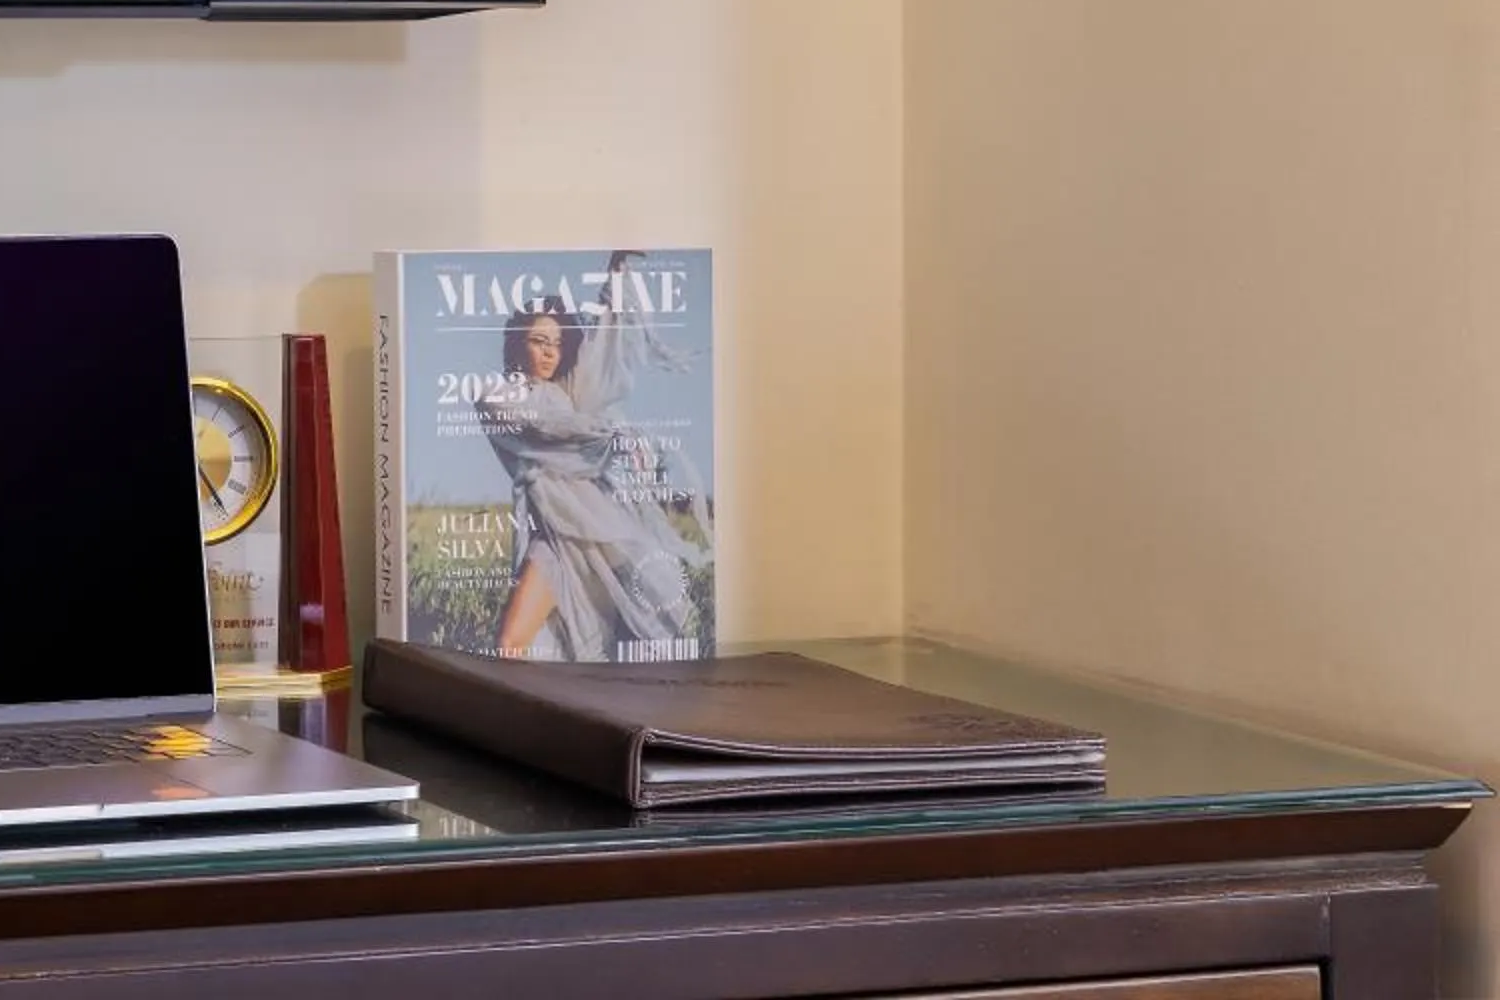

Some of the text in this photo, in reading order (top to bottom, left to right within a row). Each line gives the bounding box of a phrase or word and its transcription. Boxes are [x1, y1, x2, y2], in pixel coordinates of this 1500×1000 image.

[436, 271, 688, 317] MAGAZINE
[437, 371, 528, 406] 2023
[612, 436, 682, 452] HOW TO
[378, 314, 392, 615] FASHION MAGAZINE
[612, 454, 665, 470] STYLE
[437, 511, 538, 535] JULIANA
[437, 539, 506, 559] SILVA
